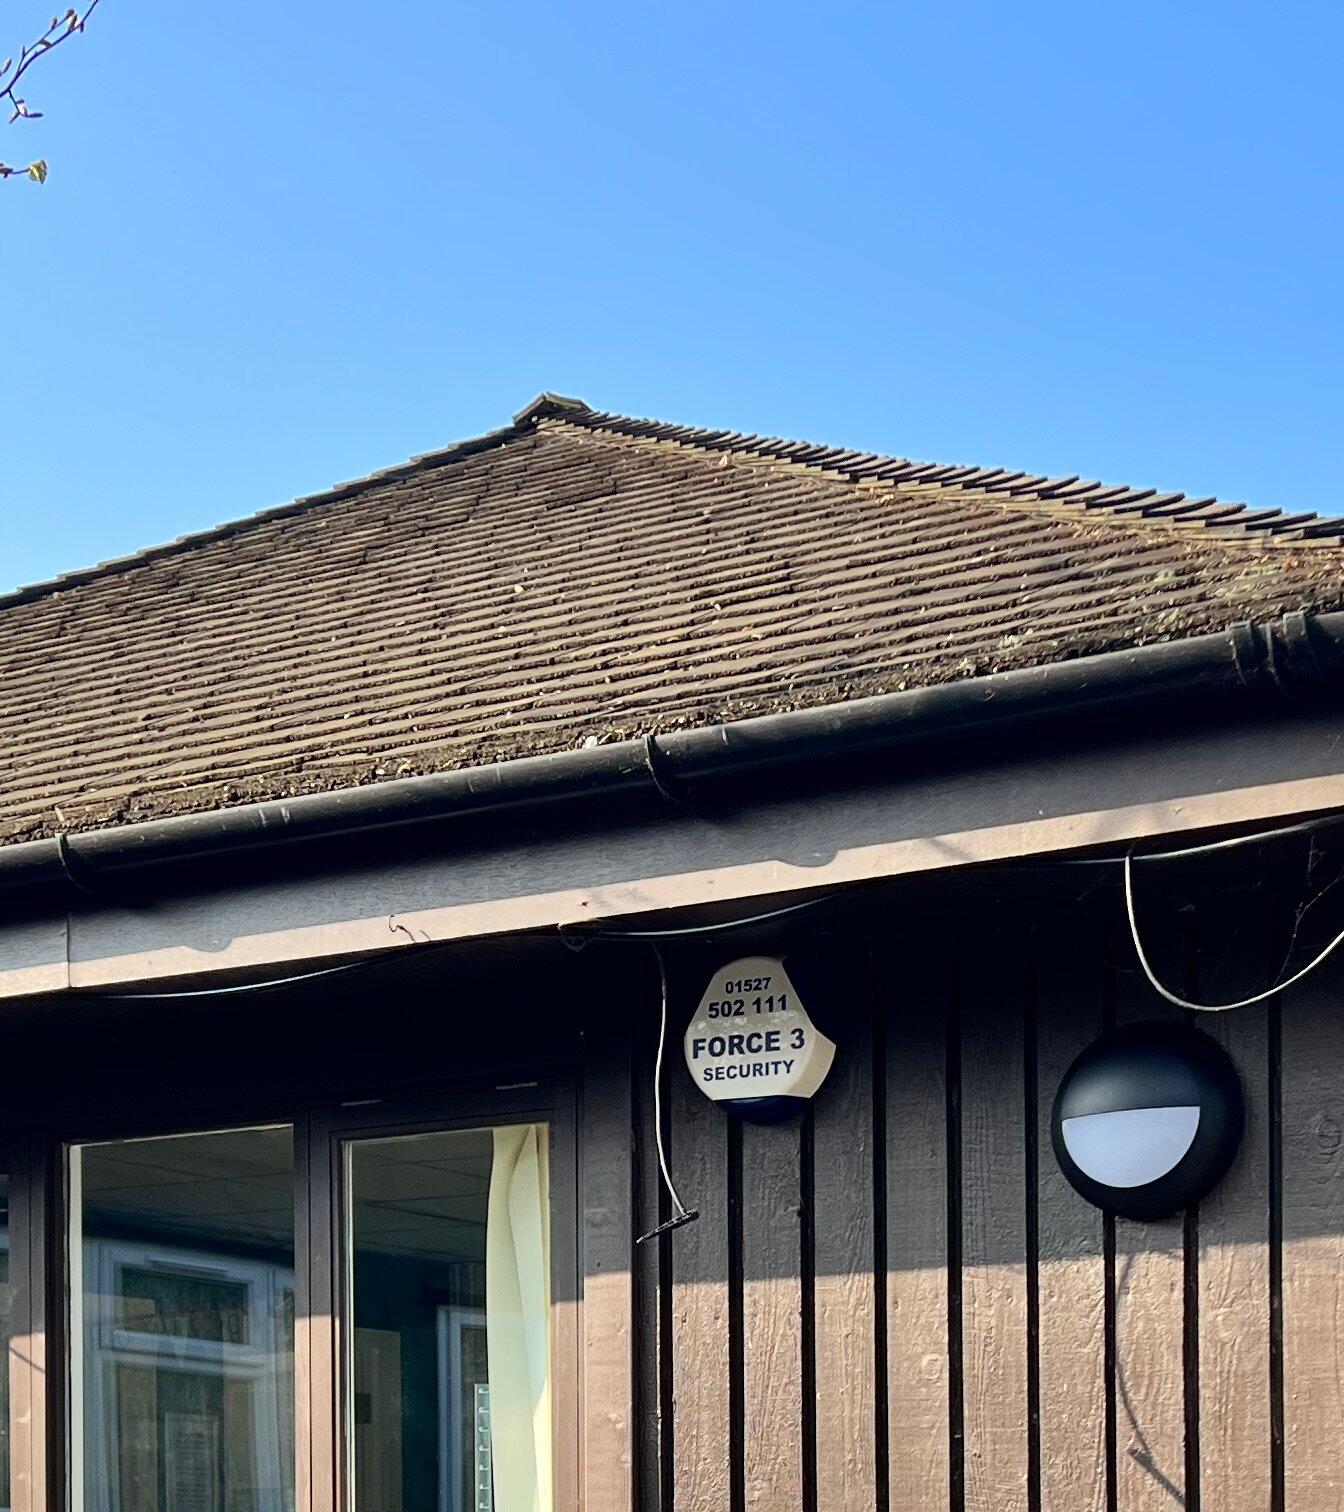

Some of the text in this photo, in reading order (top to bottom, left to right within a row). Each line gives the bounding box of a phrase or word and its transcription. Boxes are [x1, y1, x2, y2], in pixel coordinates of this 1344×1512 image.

[725, 976, 772, 995] 01527
[708, 994, 788, 1019] 502 111
[692, 1028, 805, 1060] FORCE 3
[703, 1059, 795, 1082] SECURITY
